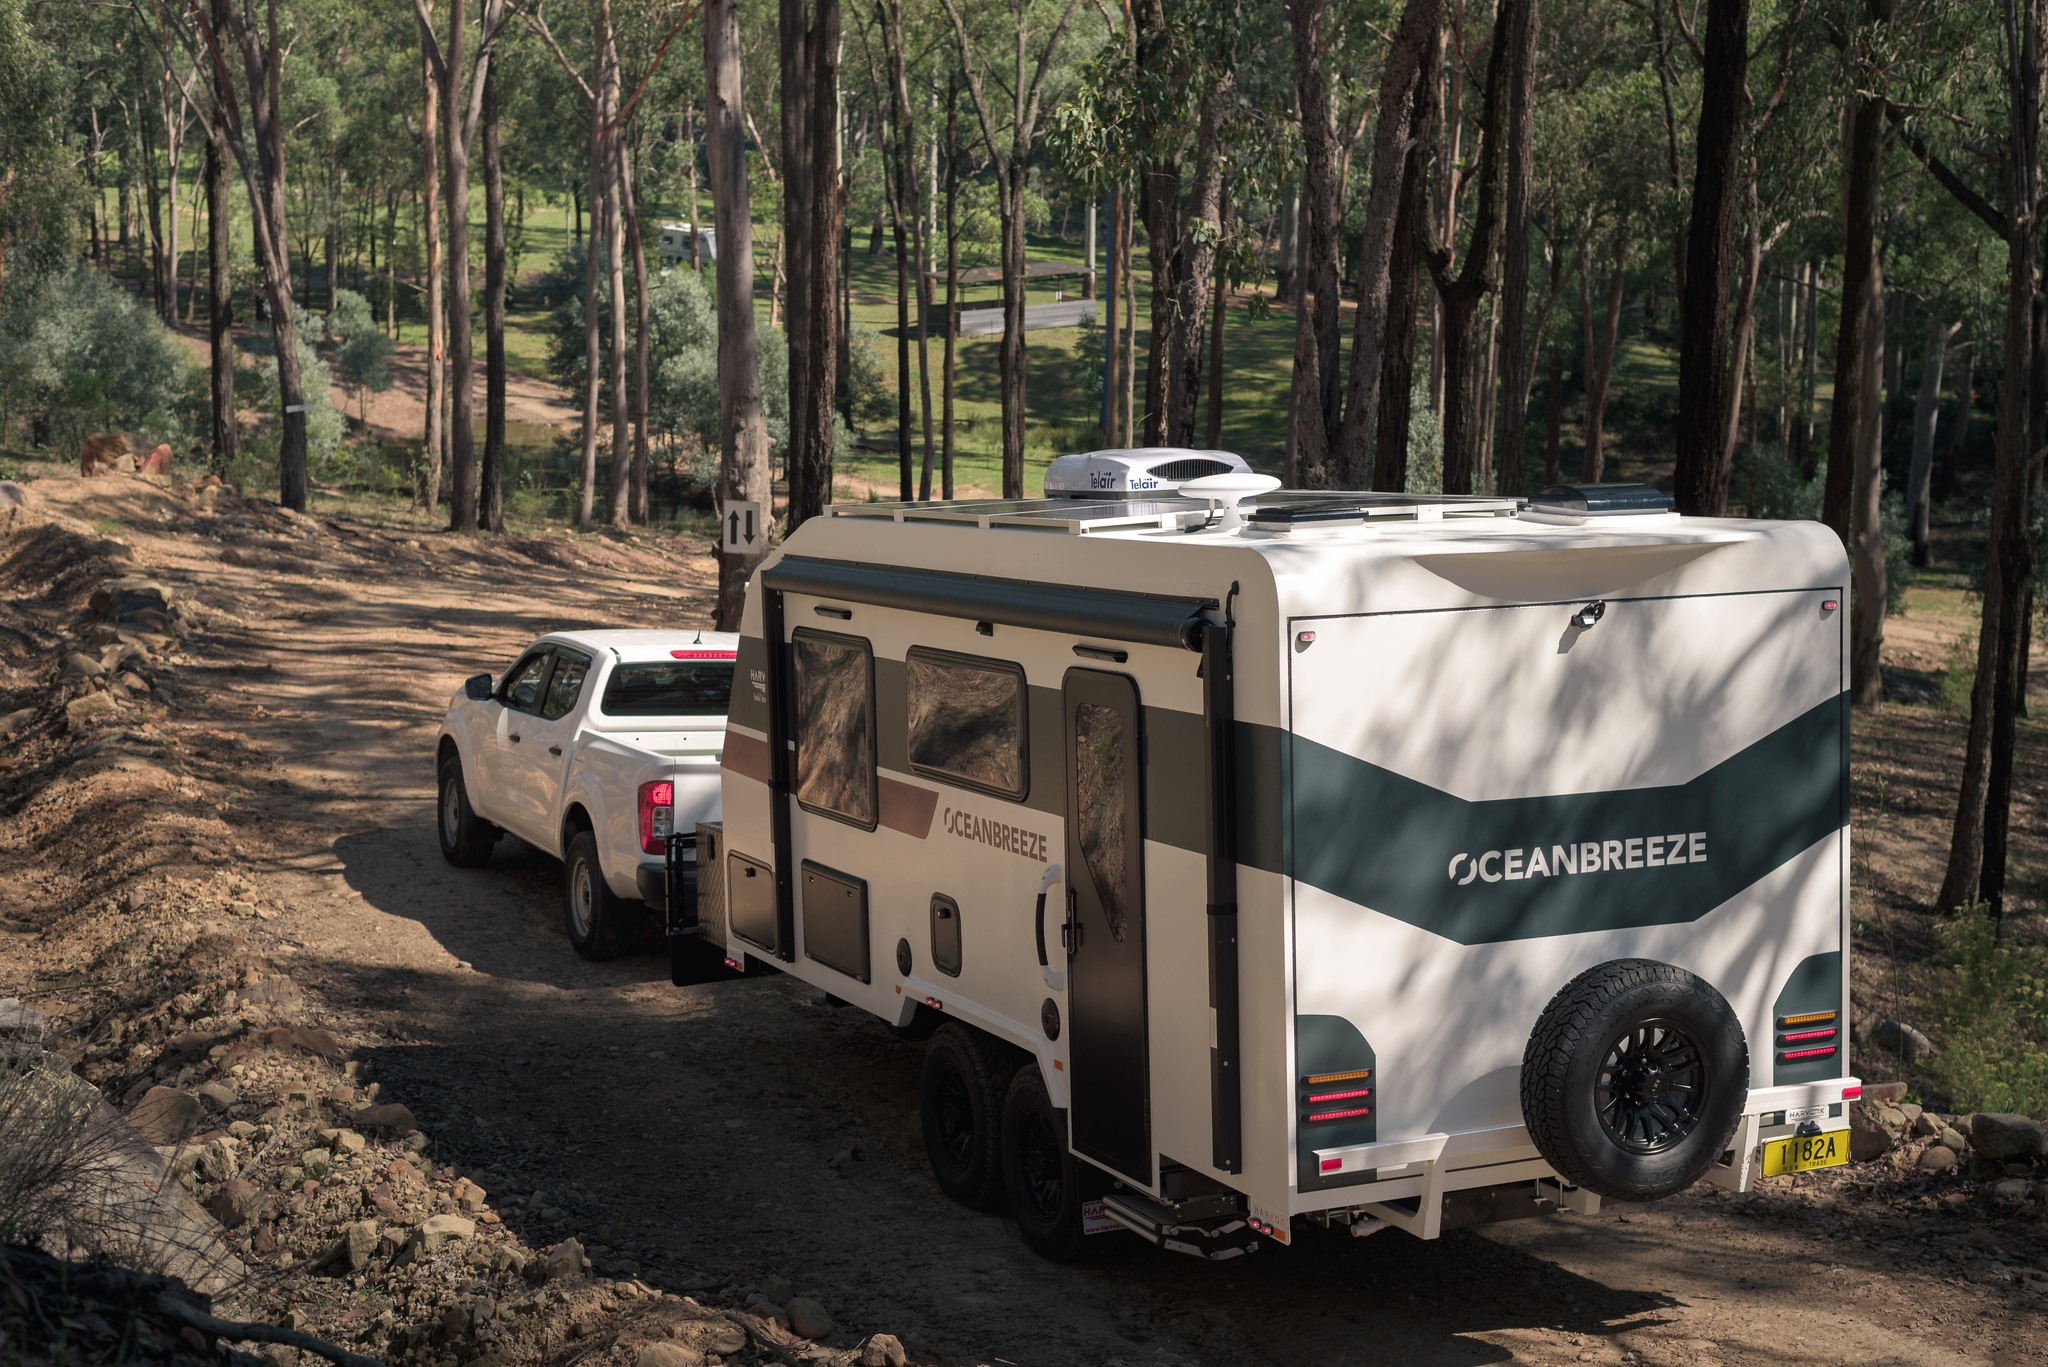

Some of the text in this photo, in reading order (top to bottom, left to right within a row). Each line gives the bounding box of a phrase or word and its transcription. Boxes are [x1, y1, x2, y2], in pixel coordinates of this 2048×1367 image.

[944, 807, 1047, 863] OCEANBREEZE
[1448, 832, 1707, 886] OCEANBREEZE
[1781, 1136, 1836, 1165] 1182A
[1809, 1159, 1827, 1168] TRADE
